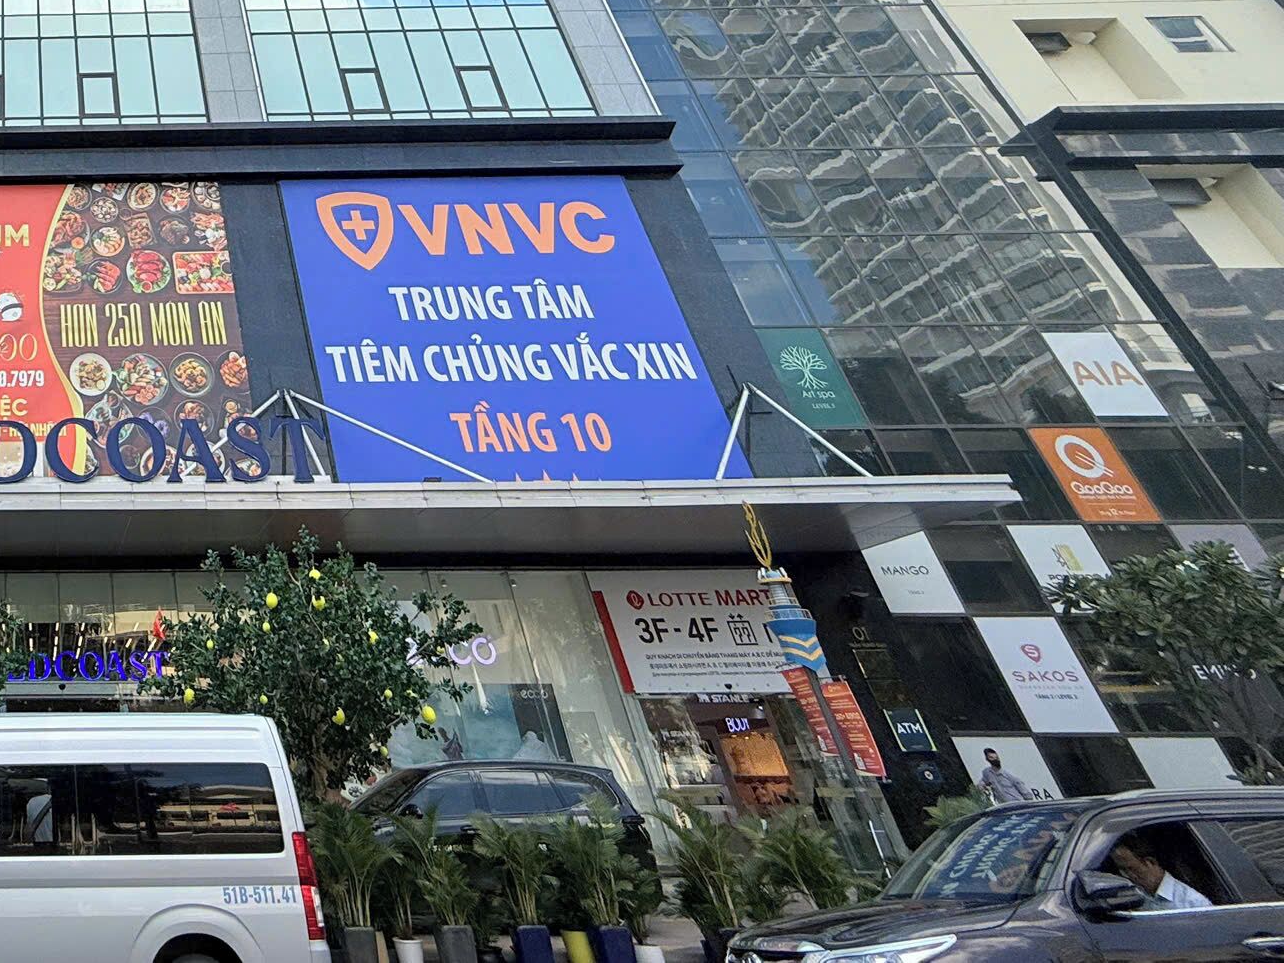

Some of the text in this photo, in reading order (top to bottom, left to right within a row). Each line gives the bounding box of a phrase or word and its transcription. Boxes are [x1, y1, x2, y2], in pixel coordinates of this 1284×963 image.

[397, 201, 615, 256] VNVC
[388, 277, 595, 322] TRUNG TÂM
[104, 302, 144, 347] 250
[326, 331, 698, 384] TIÊM CHỦNG VẮC XIN
[1071, 359, 1144, 387] AIA
[449, 400, 612, 453] TẦNG 10
[1070, 481, 1134, 494] QooQoo
[880, 565, 930, 576] MANGO
[647, 589, 771, 607] LOTTE MART
[634, 618, 669, 644] 3F
[687, 617, 719, 643] 4F
[1012, 670, 1080, 683] SAKOS
[897, 722, 923, 734] ATM
[222, 886, 297, 904] 51B-511.41
